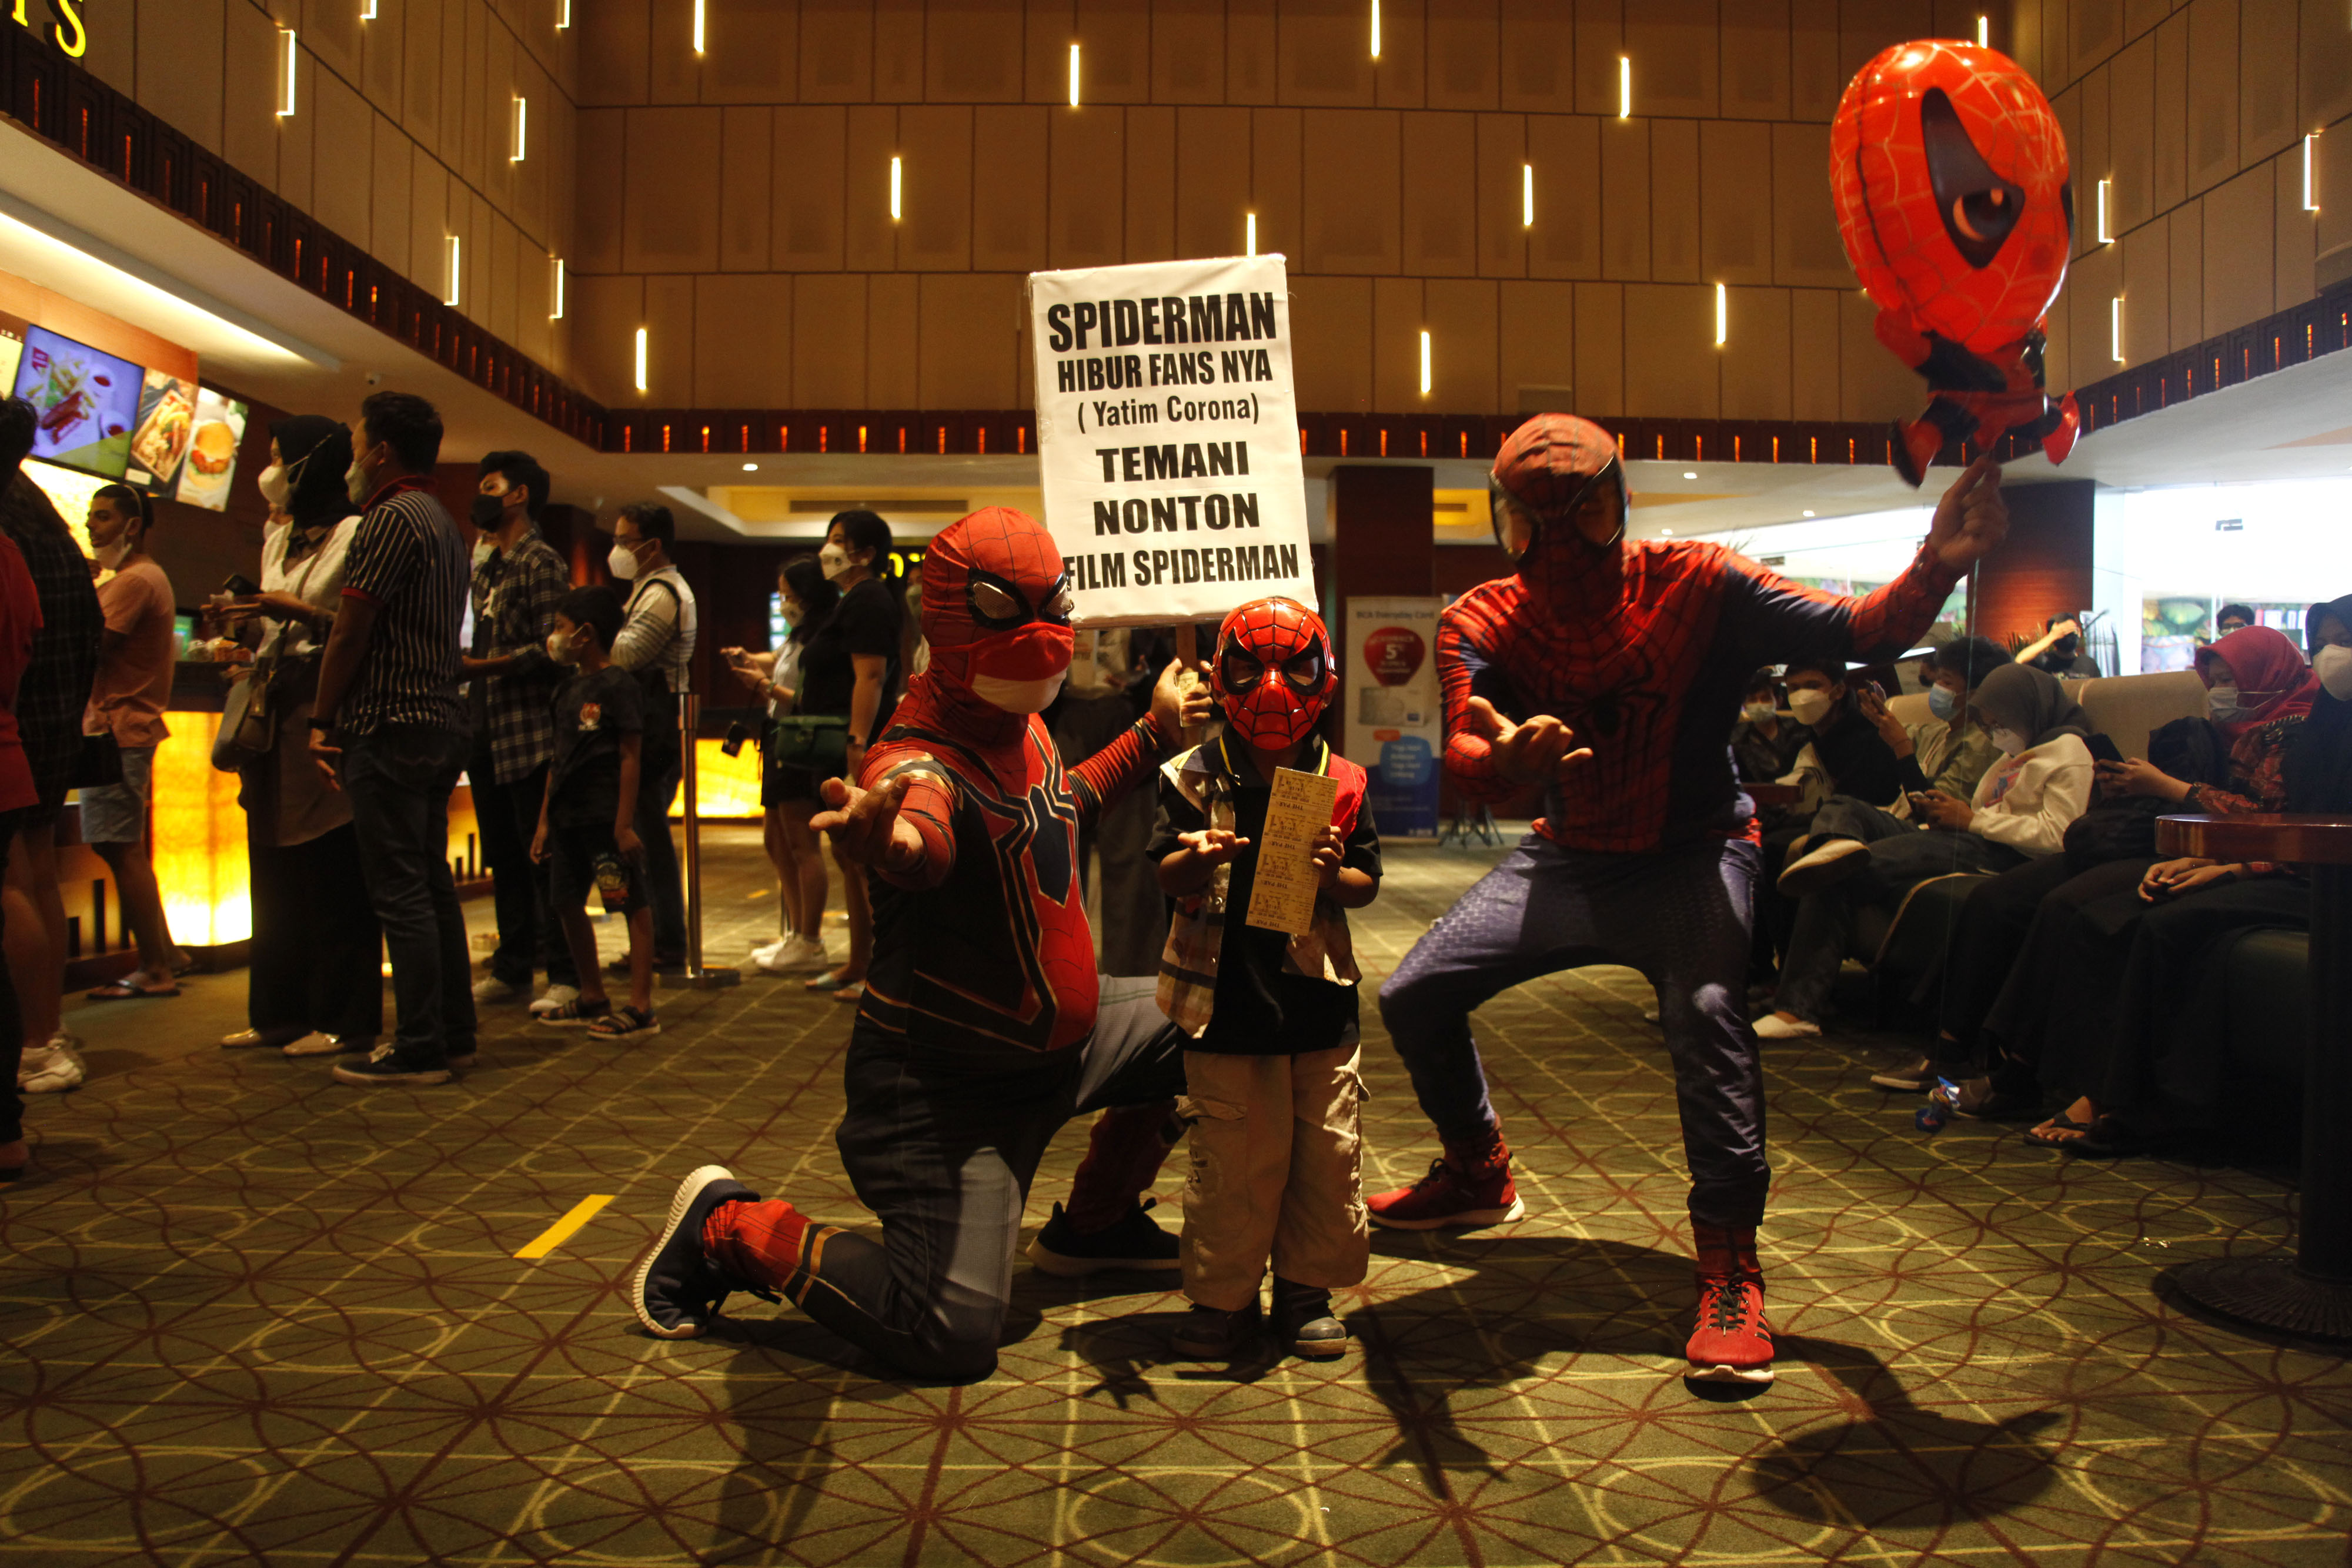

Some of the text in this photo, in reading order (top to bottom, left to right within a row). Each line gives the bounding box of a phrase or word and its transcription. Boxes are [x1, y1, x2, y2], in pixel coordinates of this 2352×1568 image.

[1048, 292, 1276, 352] SPIDERMAN
[1058, 349, 1272, 392] HIBUR FANS NYA
[1167, 393, 1258, 424] Corona)
[1096, 442, 1248, 482] TEMANI
[1094, 493, 1259, 535] NONTON
[1063, 544, 1298, 591] FILM SPIDERMAN
